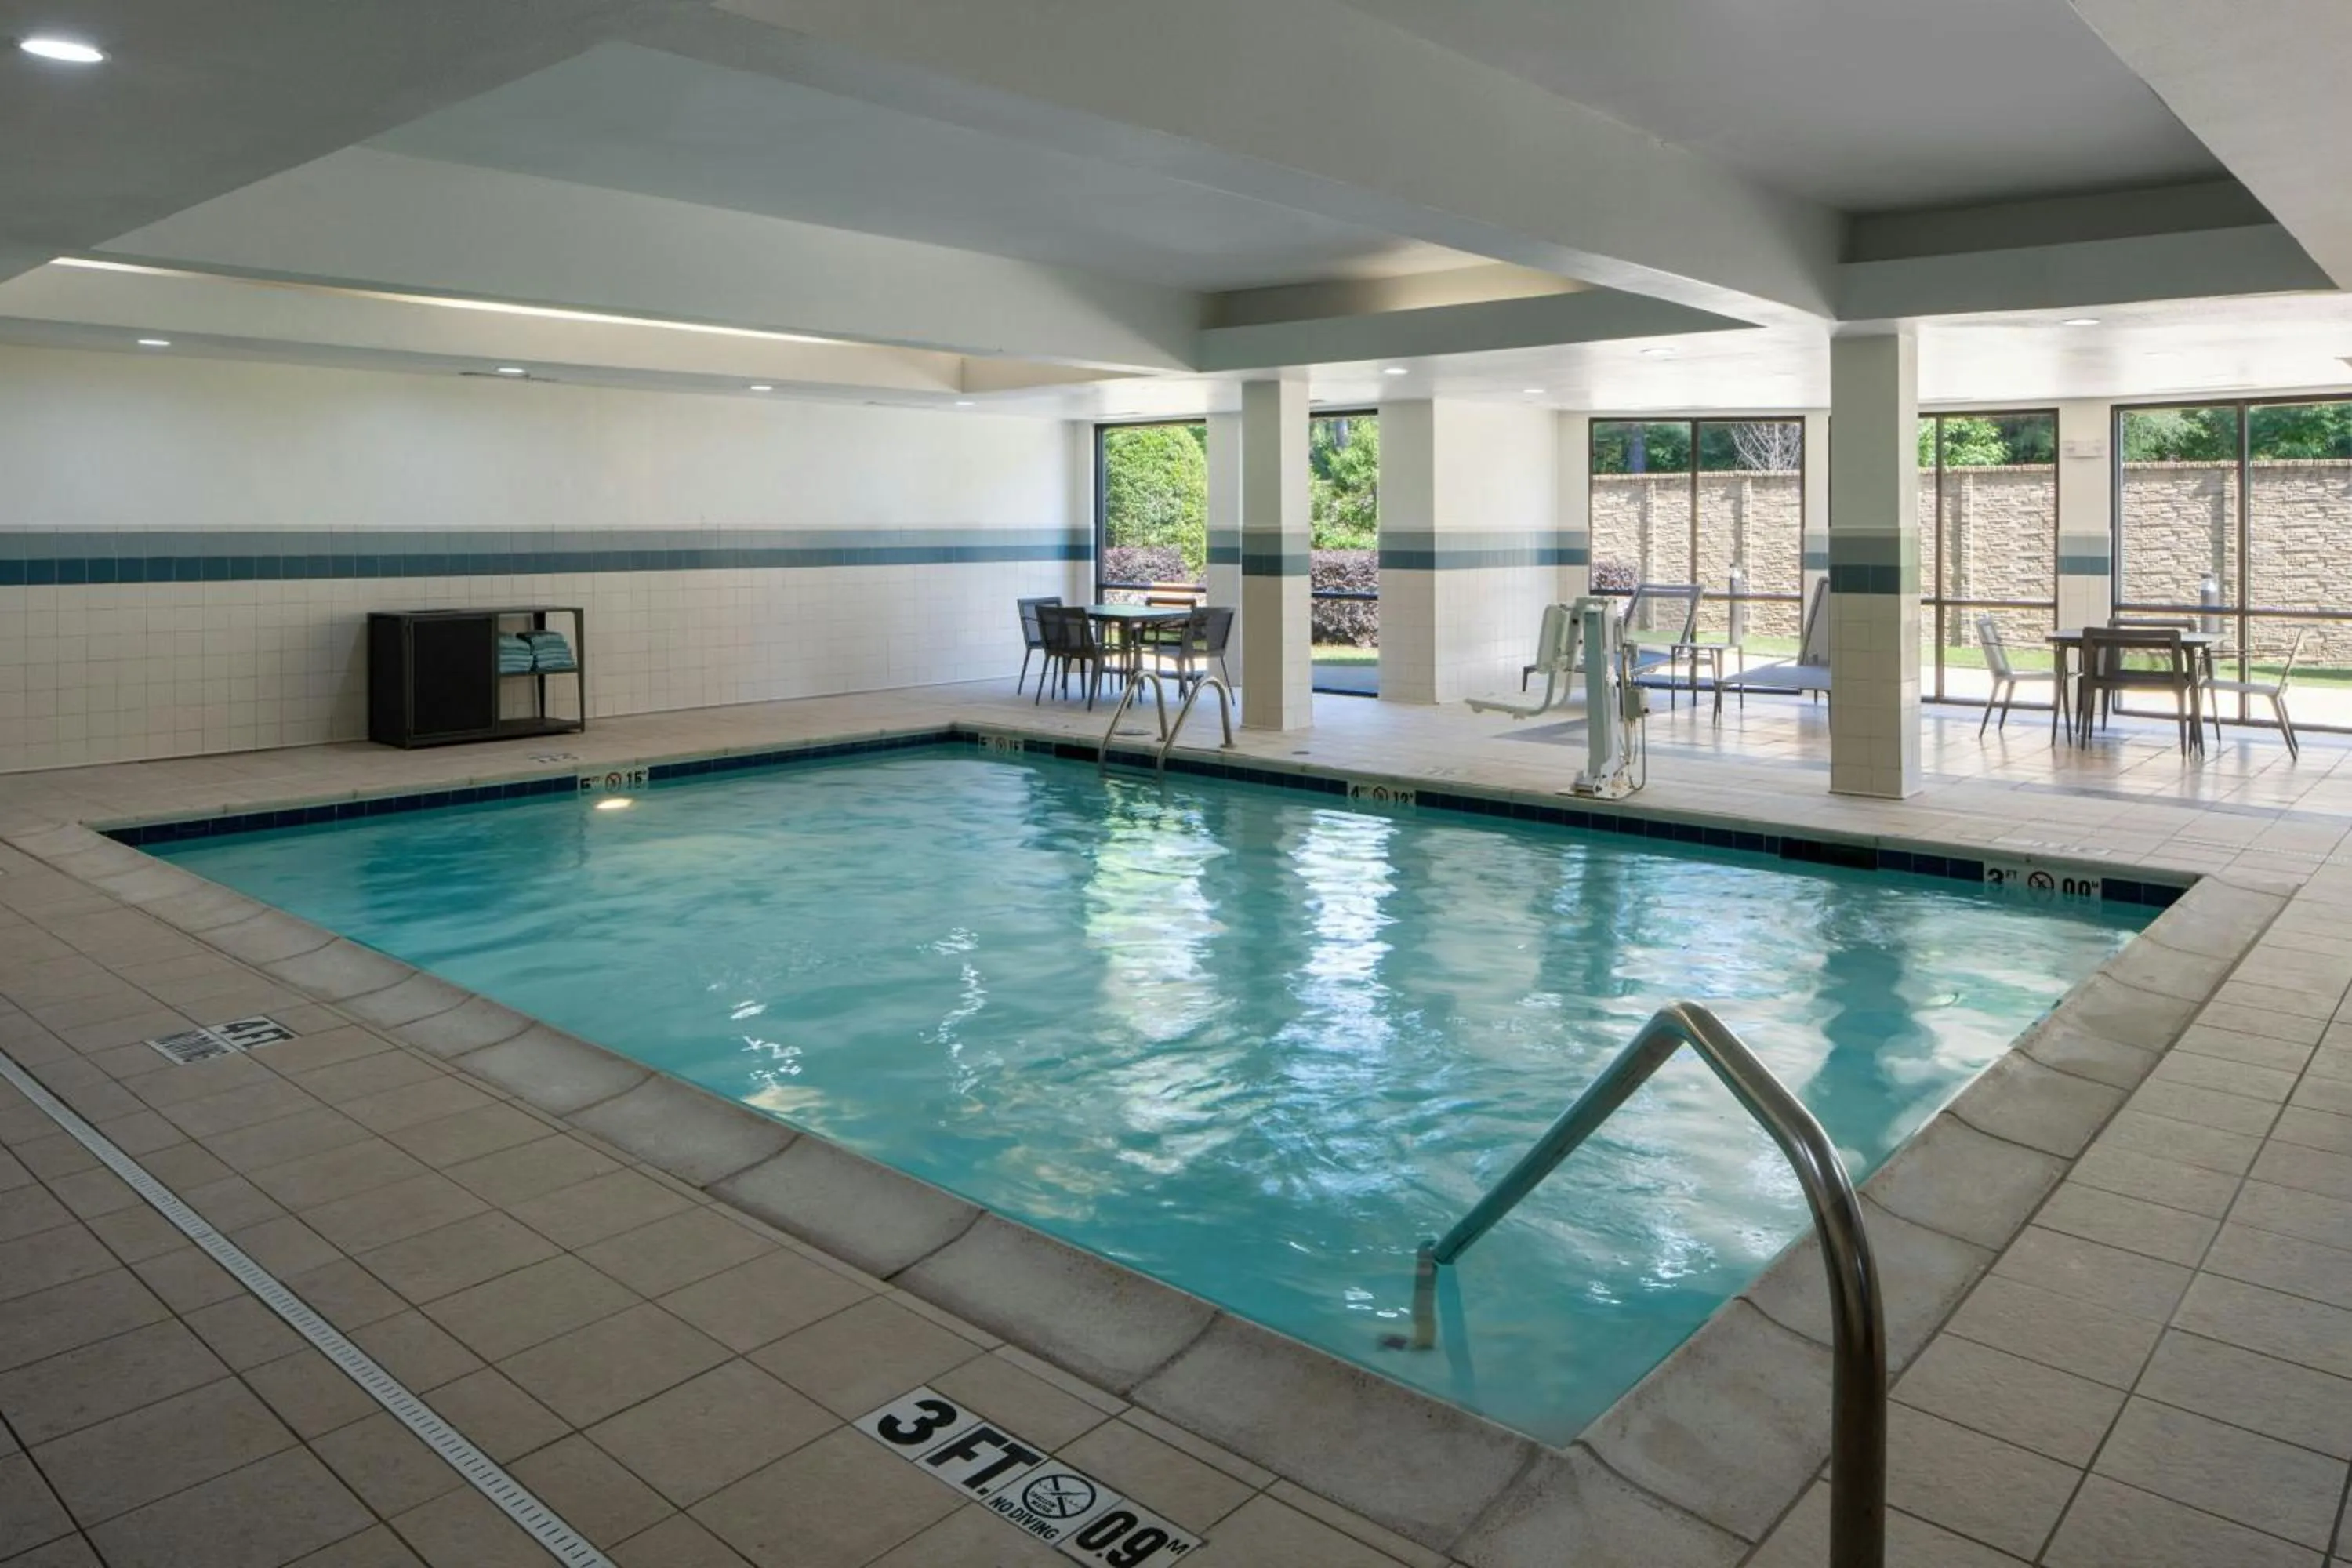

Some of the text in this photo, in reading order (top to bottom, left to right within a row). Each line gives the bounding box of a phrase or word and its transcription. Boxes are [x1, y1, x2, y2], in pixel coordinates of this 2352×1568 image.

[877, 1399, 958, 1445] 3
[989, 1496, 1059, 1539] NO DIVING
